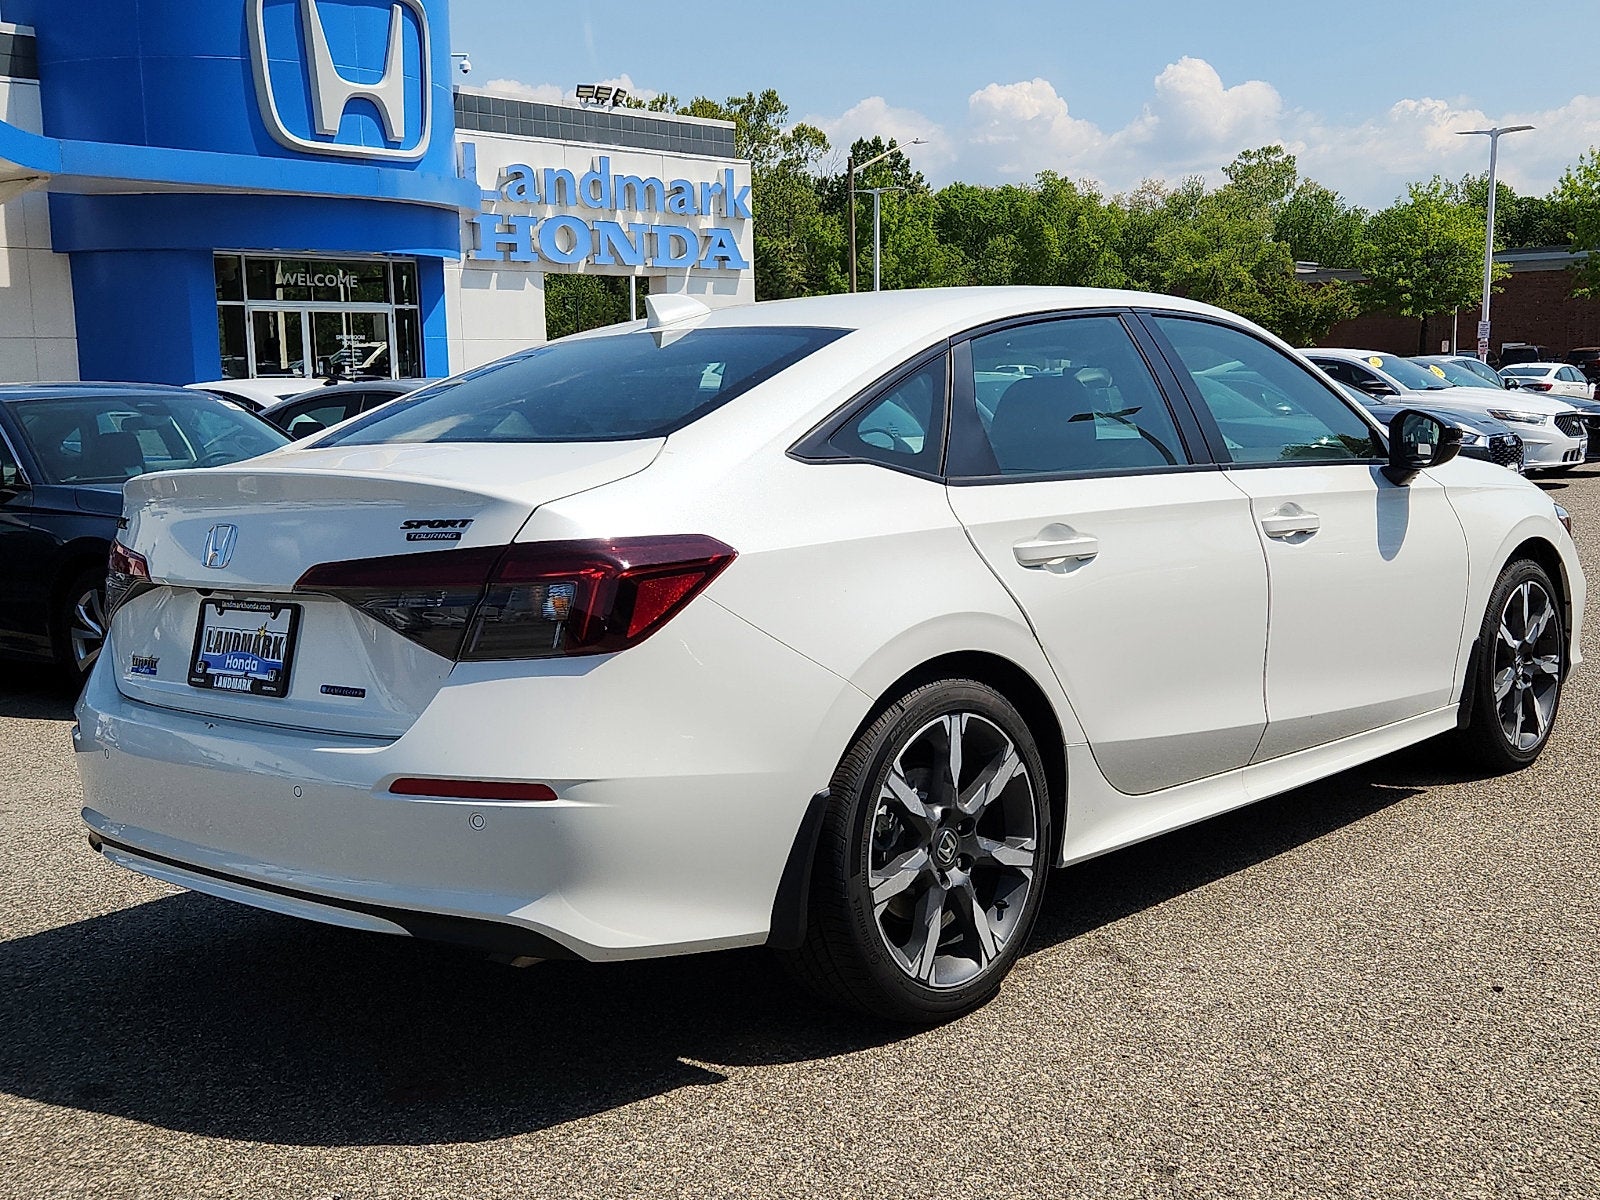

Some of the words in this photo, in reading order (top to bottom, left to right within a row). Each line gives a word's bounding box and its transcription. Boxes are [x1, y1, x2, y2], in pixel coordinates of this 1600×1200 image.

[460, 142, 750, 218] Landmark
[471, 213, 749, 270] HONDA
[281, 272, 358, 288] WELCOME
[400, 519, 475, 529] SPORT
[221, 600, 271, 611] landmarkhonda.com
[205, 629, 285, 661] LANDMARK
[225, 655, 259, 672] Honda
[213, 675, 253, 692] LANDMARK
